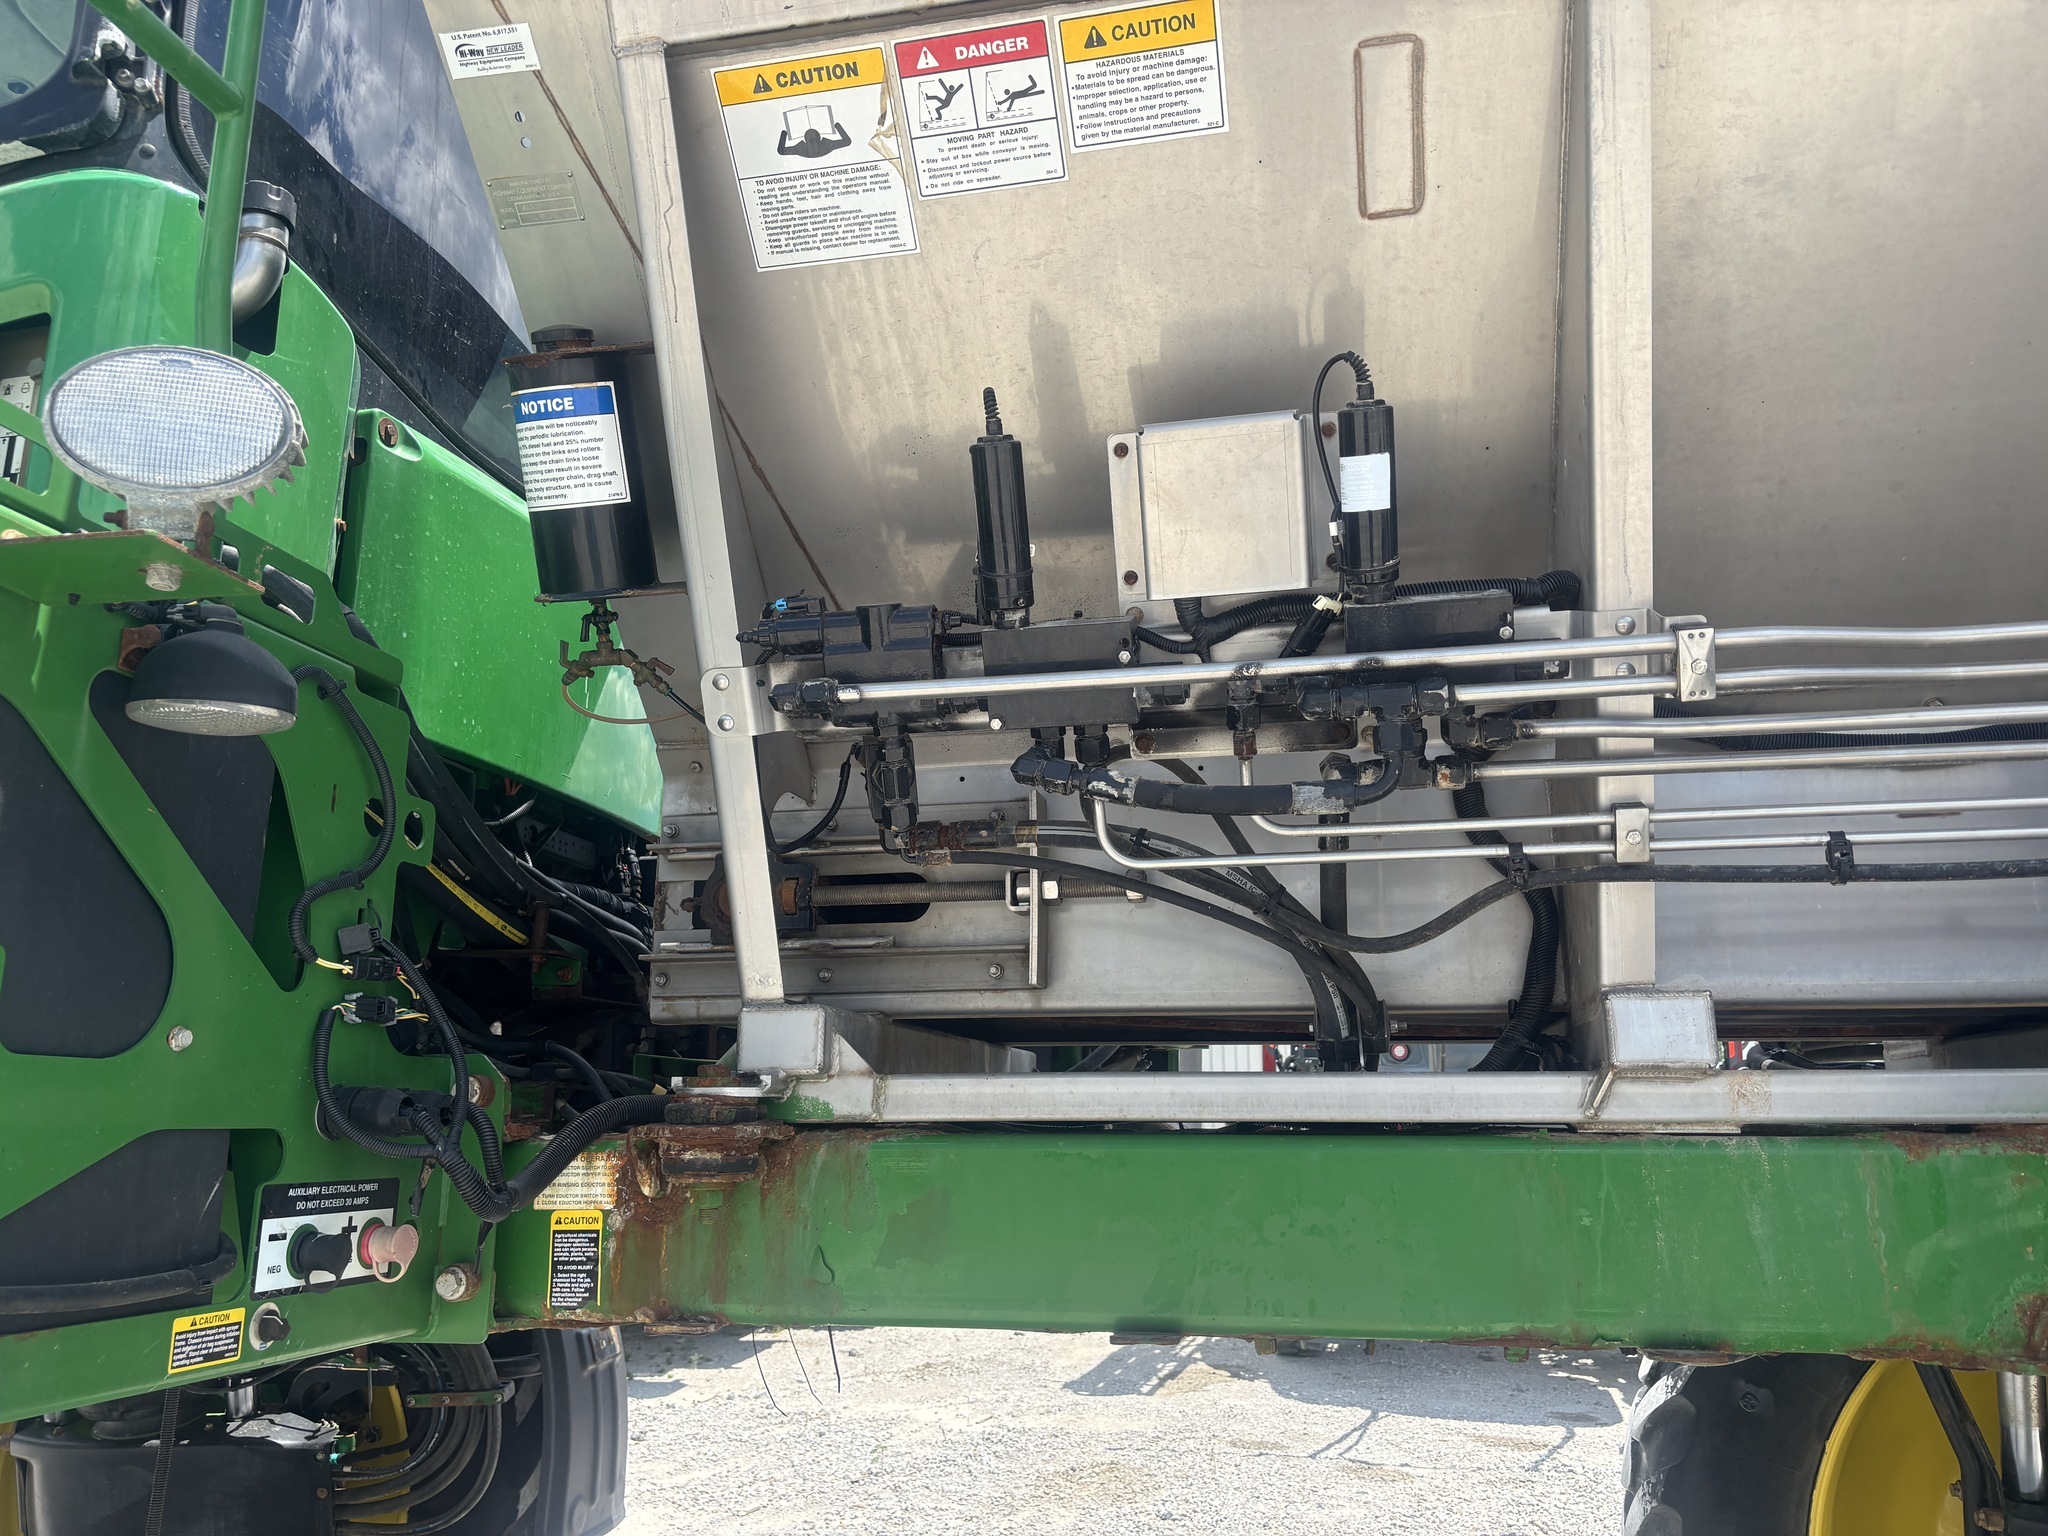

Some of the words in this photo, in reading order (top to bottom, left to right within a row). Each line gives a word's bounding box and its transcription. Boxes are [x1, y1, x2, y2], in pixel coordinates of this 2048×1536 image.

[492, 27, 518, 36] 6,817,551
[1112, 13, 1196, 41] CAUTION
[459, 48, 484, 58] Hi-Way
[501, 44, 523, 52] LEADER
[955, 37, 1029, 60] DANGER
[1095, 55, 1141, 69] HAZARDOUS
[1143, 48, 1185, 61] MATERIALS
[776, 62, 859, 88] CAUTION
[1075, 73, 1085, 81] To
[1087, 70, 1107, 79] avoid
[1109, 68, 1130, 77] injury
[1142, 61, 1174, 71] machine
[1175, 56, 1207, 66] damage:
[1075, 81, 1106, 91] Materials
[1126, 73, 1150, 84] spread
[1176, 65, 1216, 76] dangerous.
[1076, 91, 1107, 101] Improper
[1108, 86, 1142, 96] selection,
[1143, 80, 1184, 92] application,
[1077, 101, 1107, 111] handling
[1140, 92, 1164, 101] hazard
[1174, 87, 1205, 98] persons,
[1078, 111, 1107, 120] animals,
[1108, 108, 1128, 116] crops
[1138, 104, 1157, 112] other
[1158, 100, 1189, 110] property.
[1080, 122, 1102, 130] Follow
[1103, 116, 1145, 127] instructions
[1146, 113, 1159, 121] and
[1160, 108, 1201, 120] precautions
[947, 134, 975, 144] MOVING
[977, 131, 995, 140] PART
[999, 126, 1029, 137] HAZARD
[1081, 132, 1100, 141] given
[1123, 124, 1151, 134] material
[1152, 118, 1200, 130] manufacturer.
[947, 144, 968, 153] prevent
[998, 137, 1019, 145] serious
[992, 147, 1017, 155] conveyor
[927, 164, 958, 173] Disconnect
[971, 159, 992, 167] lockout
[993, 157, 1011, 165] power
[928, 172, 954, 180] adjusting
[963, 167, 990, 175] servicing.
[755, 179, 765, 187] TO
[765, 177, 785, 186] AVOID
[785, 174, 808, 183] INJURY
[809, 172, 819, 180] OR
[820, 168, 850, 178] MACHINE
[850, 164, 881, 174] DAMAGE:
[976, 175, 1002, 183] spreader.
[521, 397, 574, 415] NOTICE
[565, 419, 598, 427] noticeably
[529, 433, 549, 441] periodic
[550, 430, 585, 438] lubrication.
[1225, 869, 1248, 888] MSHA
[288, 1186, 321, 1197] AUXILIARY
[321, 1184, 357, 1195] ELECTRICAL
[358, 1183, 379, 1192] POWER
[296, 1201, 306, 1210] DO
[306, 1200, 320, 1209] NOT
[320, 1198, 345, 1208] EXCEED
[345, 1198, 352, 1206] 30
[352, 1196, 369, 1205] AMPS
[563, 1216, 599, 1225] CAUTION
[267, 1265, 282, 1274] NEG
[199, 1313, 230, 1326] CAUTION
